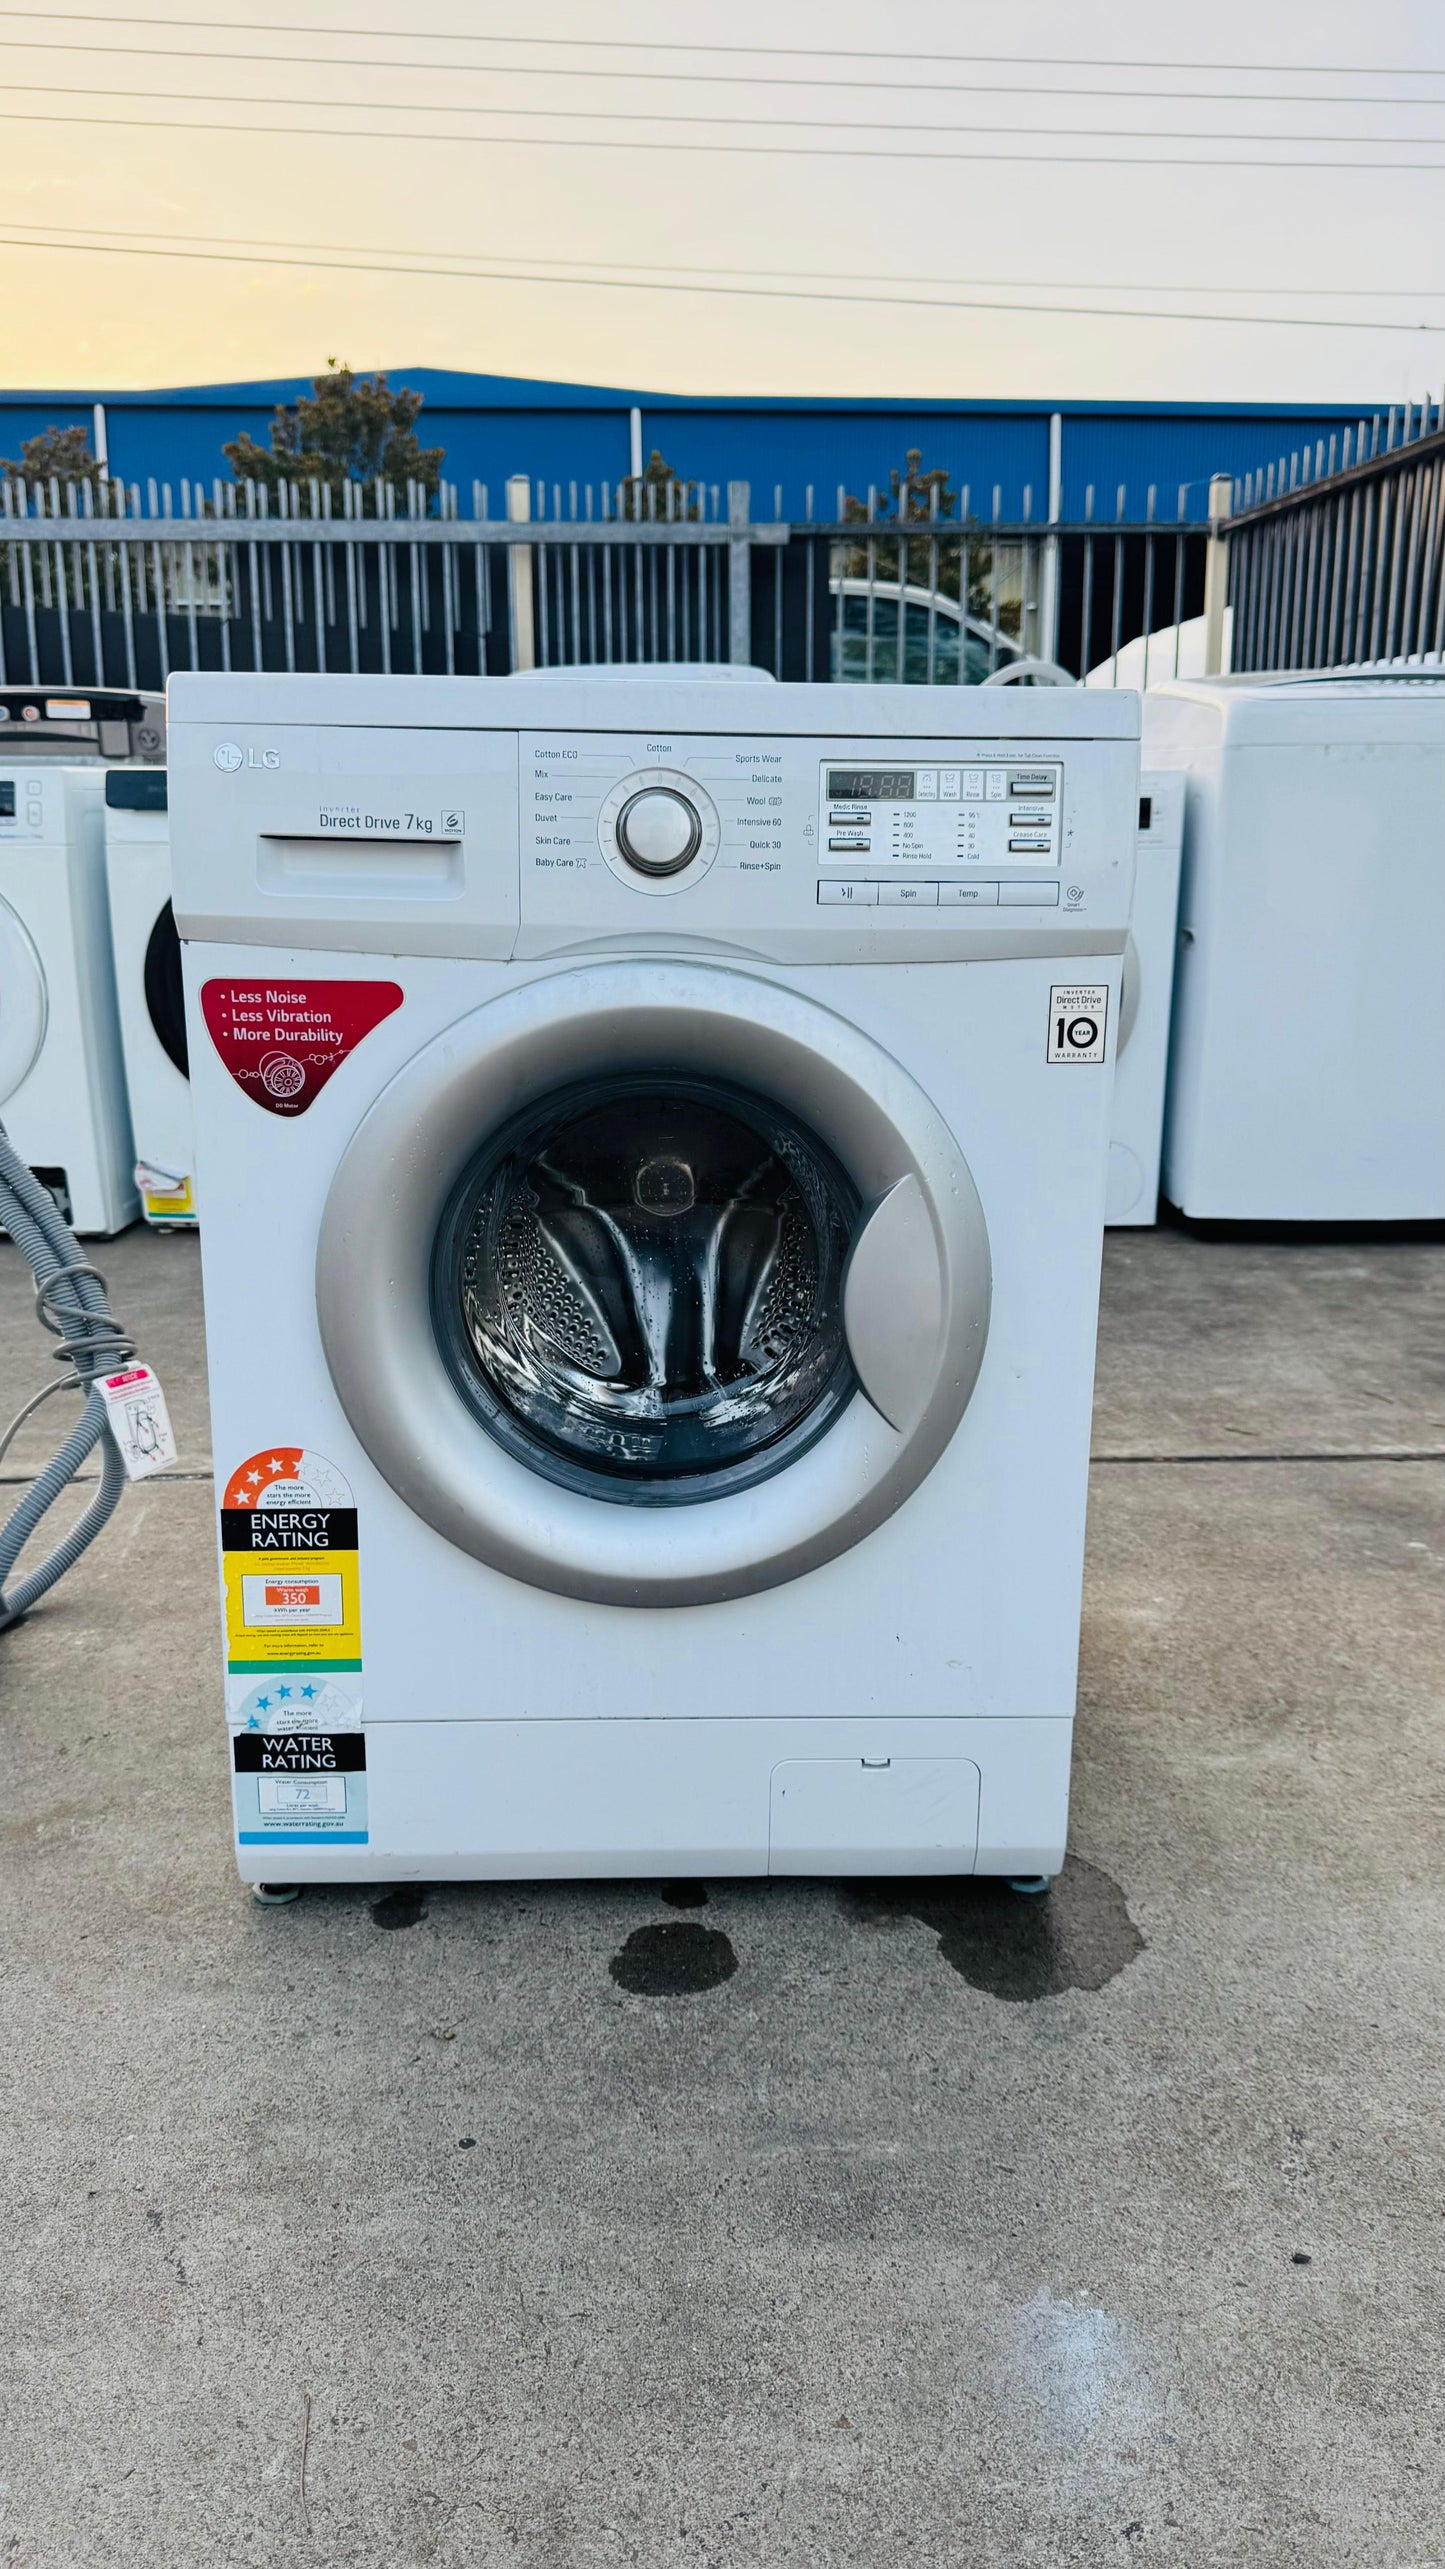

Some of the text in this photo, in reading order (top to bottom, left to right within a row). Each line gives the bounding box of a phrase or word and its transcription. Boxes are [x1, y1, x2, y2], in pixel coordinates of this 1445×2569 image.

[647, 744, 671, 753] Cotton
[248, 748, 280, 769] LG
[535, 750, 578, 759] Cotton ECO
[736, 755, 759, 763] Sports
[535, 770, 548, 778] Mix
[752, 775, 782, 783] Delicate
[535, 793, 553, 802] Easy
[747, 797, 766, 805] Wool
[320, 814, 360, 828] Direct
[365, 816, 400, 829] Drive
[535, 814, 557, 822] Duvet
[750, 841, 769, 850] Quick
[536, 859, 554, 868] Baby
[740, 862, 781, 871] Rinse+Spin
[900, 890, 917, 898] Spin
[959, 890, 978, 898] Temp
[231, 990, 306, 1004] Less Noise
[232, 1009, 331, 1023] Less Vibration
[234, 1028, 343, 1045] More Durability
[1057, 1017, 1098, 1048] 10
[251, 1513, 330, 1529] ENERGY
[252, 1532, 329, 1547] RATING
[283, 1593, 306, 1604] 350
[263, 1737, 333, 1751] WATER
[263, 1755, 336, 1769] RATING
[295, 1789, 310, 1799] 72
